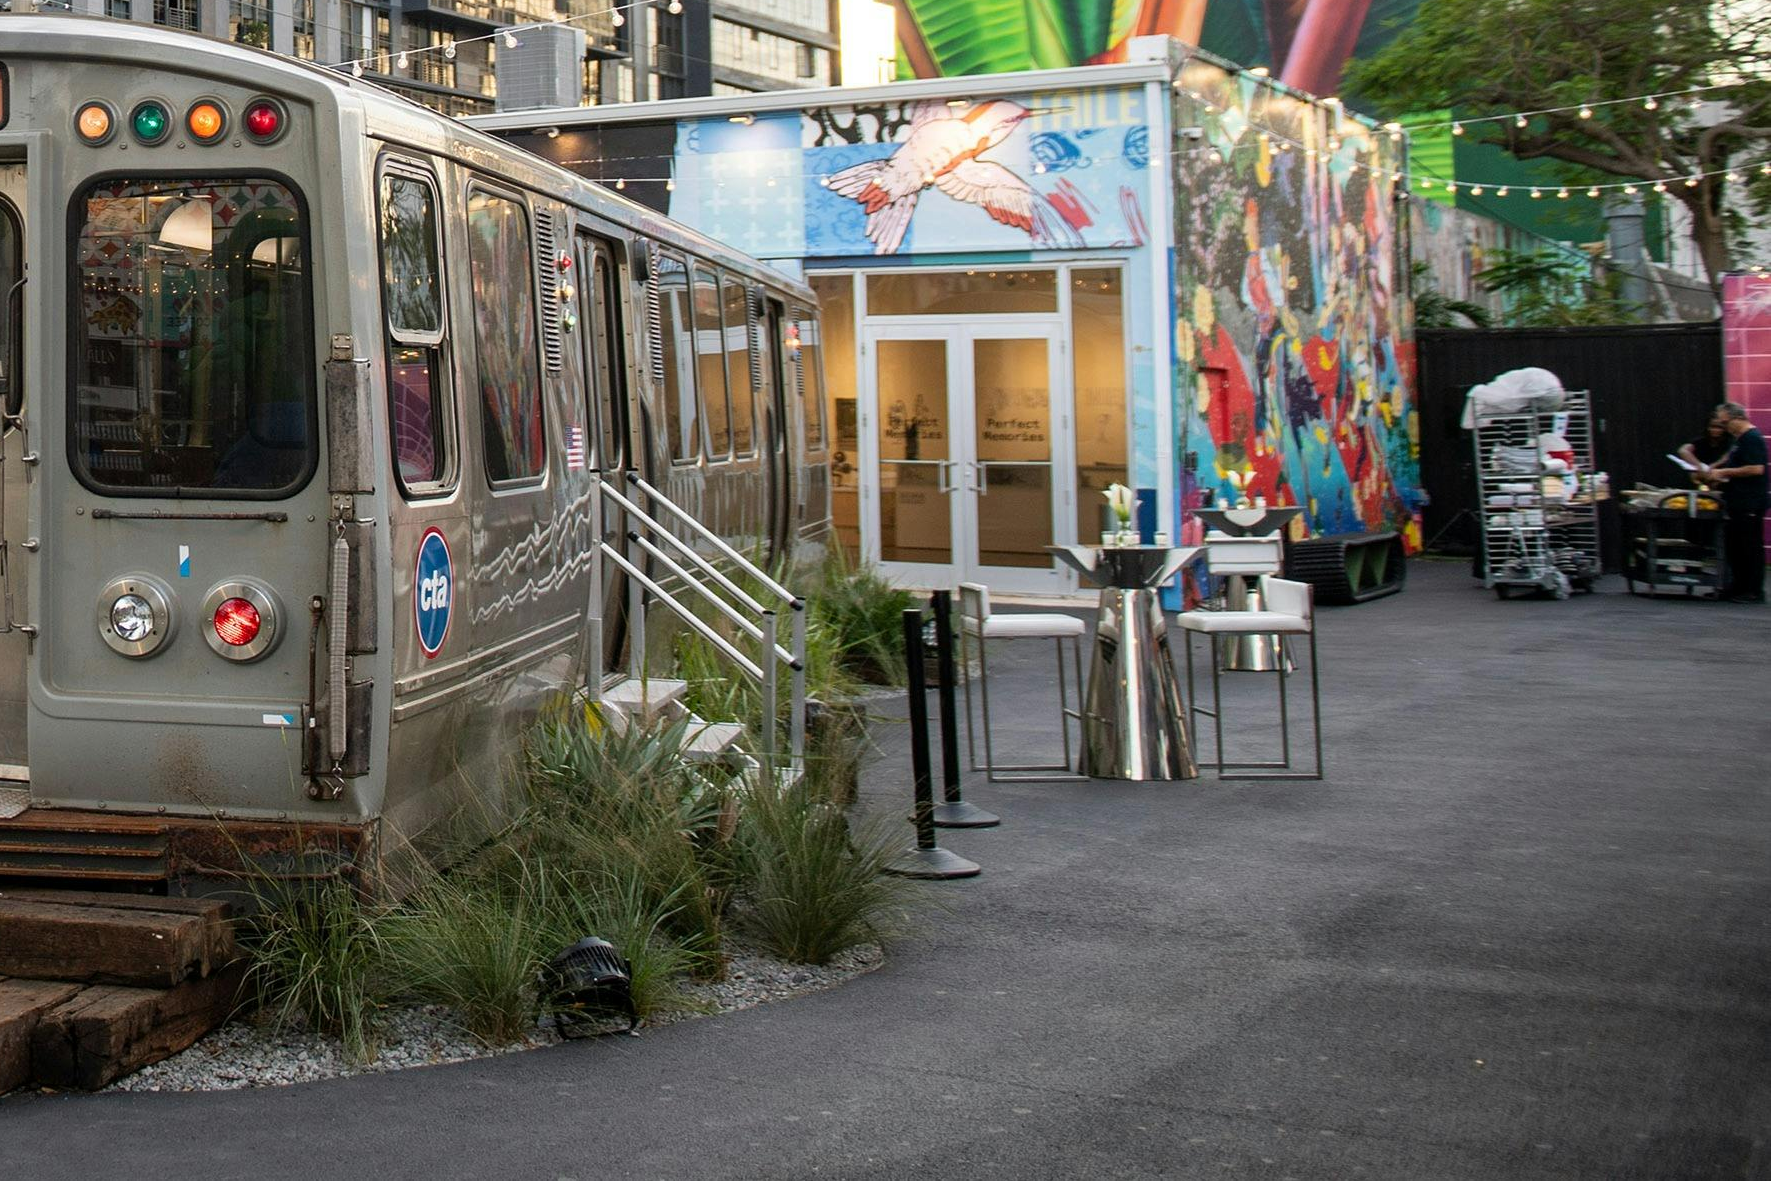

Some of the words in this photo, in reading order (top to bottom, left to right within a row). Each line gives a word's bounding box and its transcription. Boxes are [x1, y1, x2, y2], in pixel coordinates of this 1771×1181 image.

[987, 418, 1041, 430] Perfect
[983, 431, 1046, 442] Memories
[421, 570, 448, 611] cta
